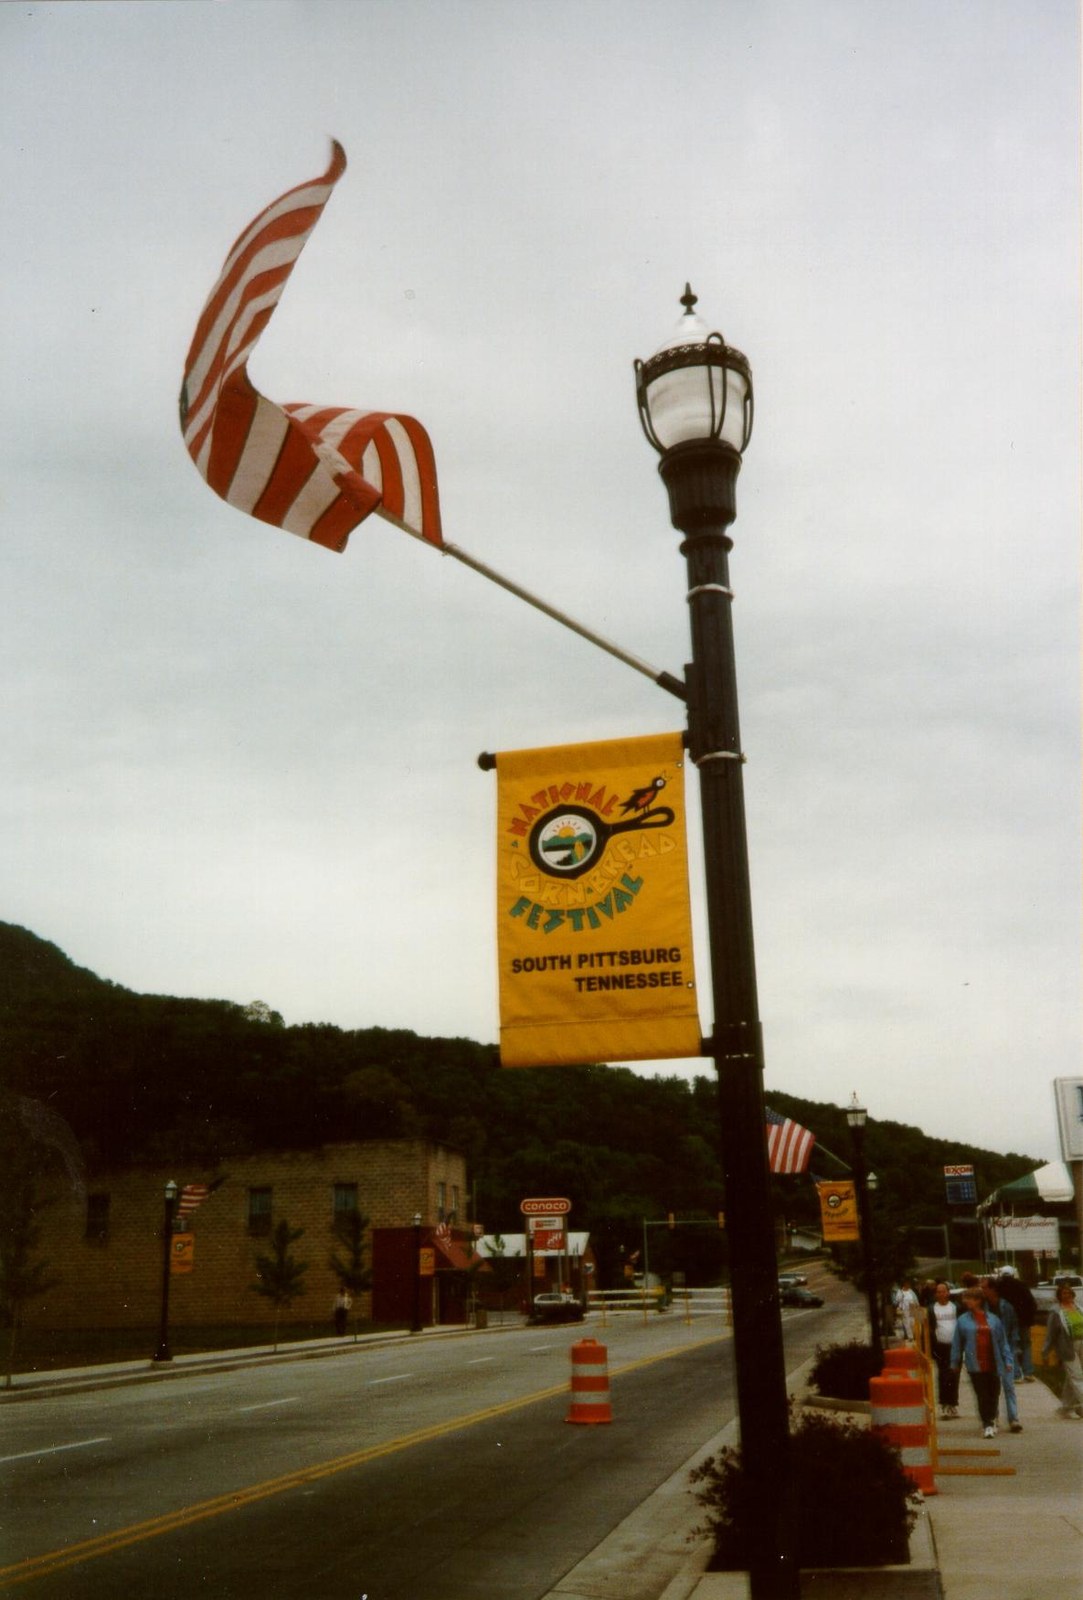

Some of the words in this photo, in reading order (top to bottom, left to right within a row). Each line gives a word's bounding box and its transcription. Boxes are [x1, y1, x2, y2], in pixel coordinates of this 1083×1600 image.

[507, 782, 620, 836] NATIONAL
[509, 873, 643, 934] FESTIVAL
[512, 955, 572, 973] SOUTH
[577, 948, 681, 969] PITTSBURG
[574, 972, 682, 992] TENNESSEE
